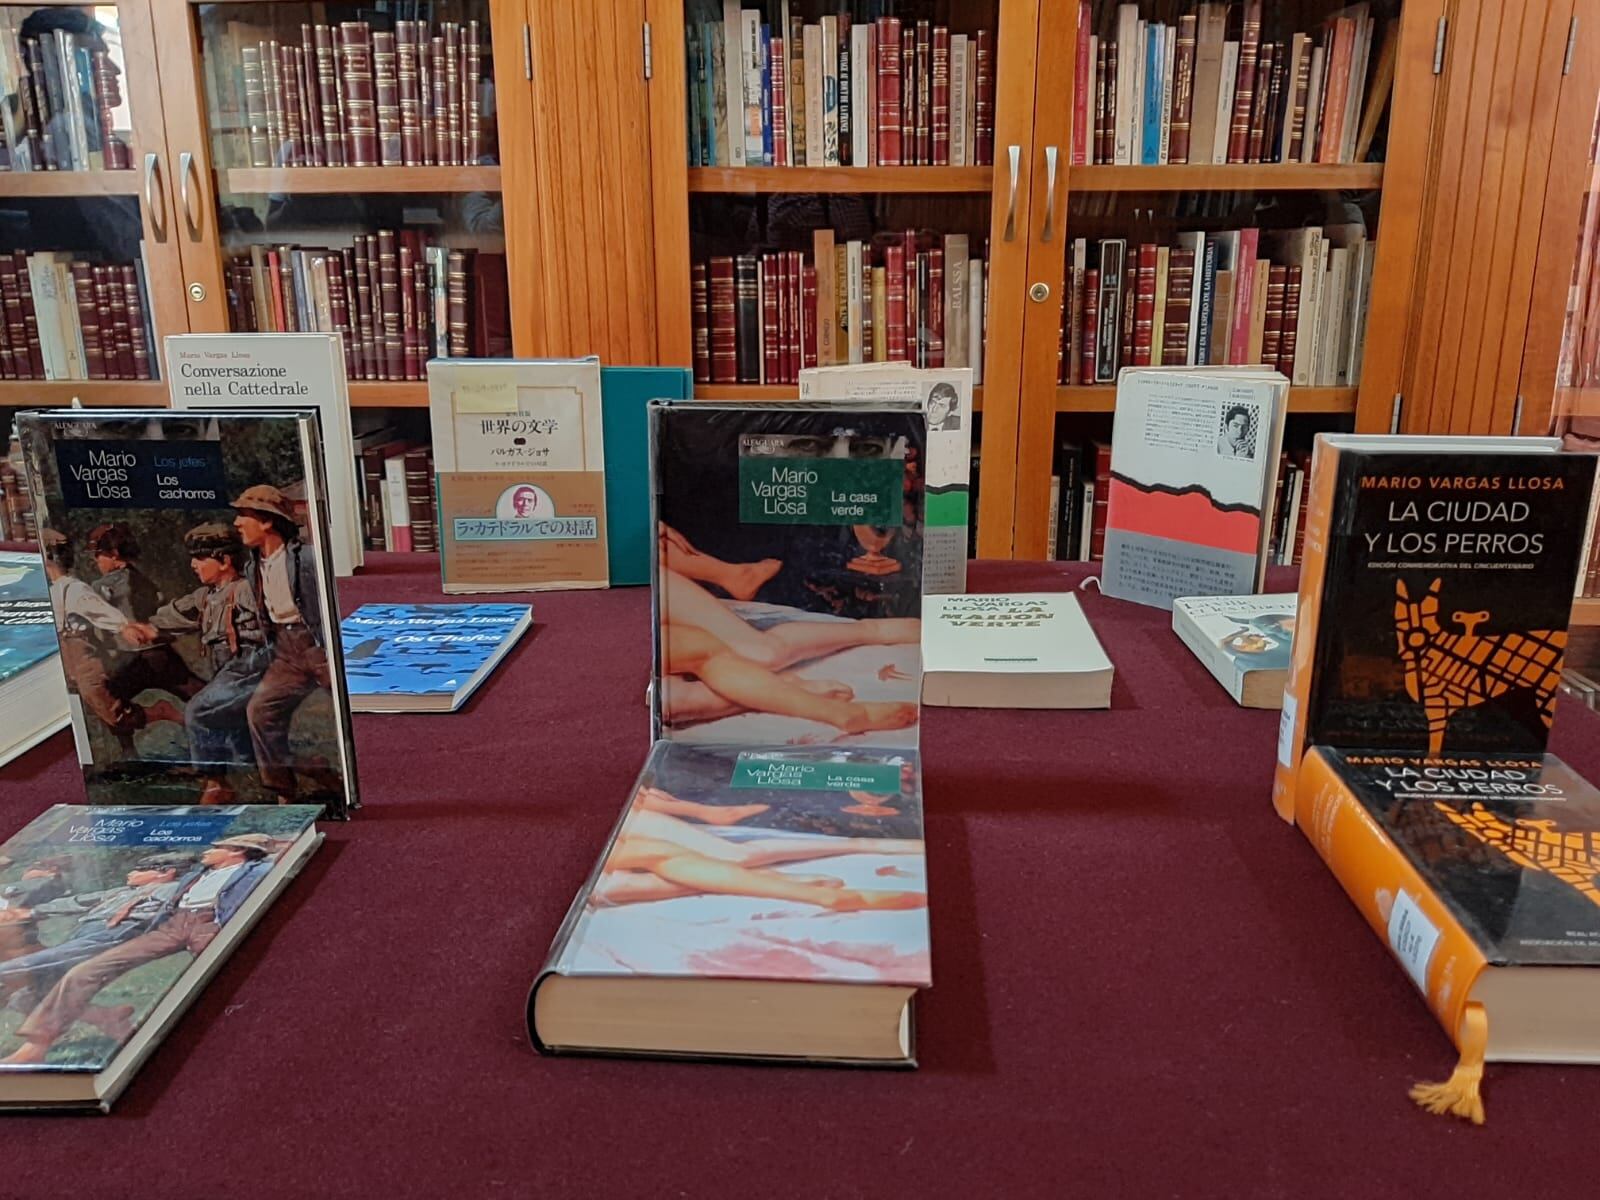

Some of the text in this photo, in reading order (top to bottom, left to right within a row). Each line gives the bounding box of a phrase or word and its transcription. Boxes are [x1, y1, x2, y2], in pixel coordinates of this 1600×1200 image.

[181, 362, 287, 378] Conversazione
[184, 380, 309, 396] nella Cattedrale
[481, 419, 559, 435] 世界の文学
[88, 449, 137, 467] Mario
[153, 455, 176, 468] Los
[69, 463, 128, 485] Vargas
[156, 473, 179, 486] Los
[771, 466, 819, 484] Mario
[1360, 475, 1565, 490] MARIO VARGAS LLOSA
[86, 482, 132, 499] Llosa
[158, 487, 217, 500] cachorros
[751, 481, 807, 501] Vargas
[831, 490, 878, 504] La casa
[764, 498, 807, 515] Llosa
[831, 504, 864, 516] verde
[1388, 500, 1531, 523] LA CIUDAD
[456, 518, 594, 537] ラ・カテドラルでの対話
[1364, 532, 1545, 555] Y LOS PERROS
[352, 616, 517, 626] Mario Vargas Llosa
[939, 612, 1055, 620] MAISON
[949, 620, 1041, 628] VERTE
[394, 633, 503, 643] Os Chefes
[768, 763, 815, 773] Mario
[1346, 756, 1543, 769] MARIO VARGAS LLOSA
[746, 768, 803, 779] Vargas
[757, 775, 802, 785] Llosa
[1384, 766, 1528, 781] LA CIUDAD
[1373, 779, 1564, 795] Y LOS PERROS
[68, 824, 126, 835] Vargas
[95, 818, 145, 828] Mario
[67, 832, 117, 843] Llosa
[149, 828, 173, 836] Los
[142, 835, 203, 843] cachorros
